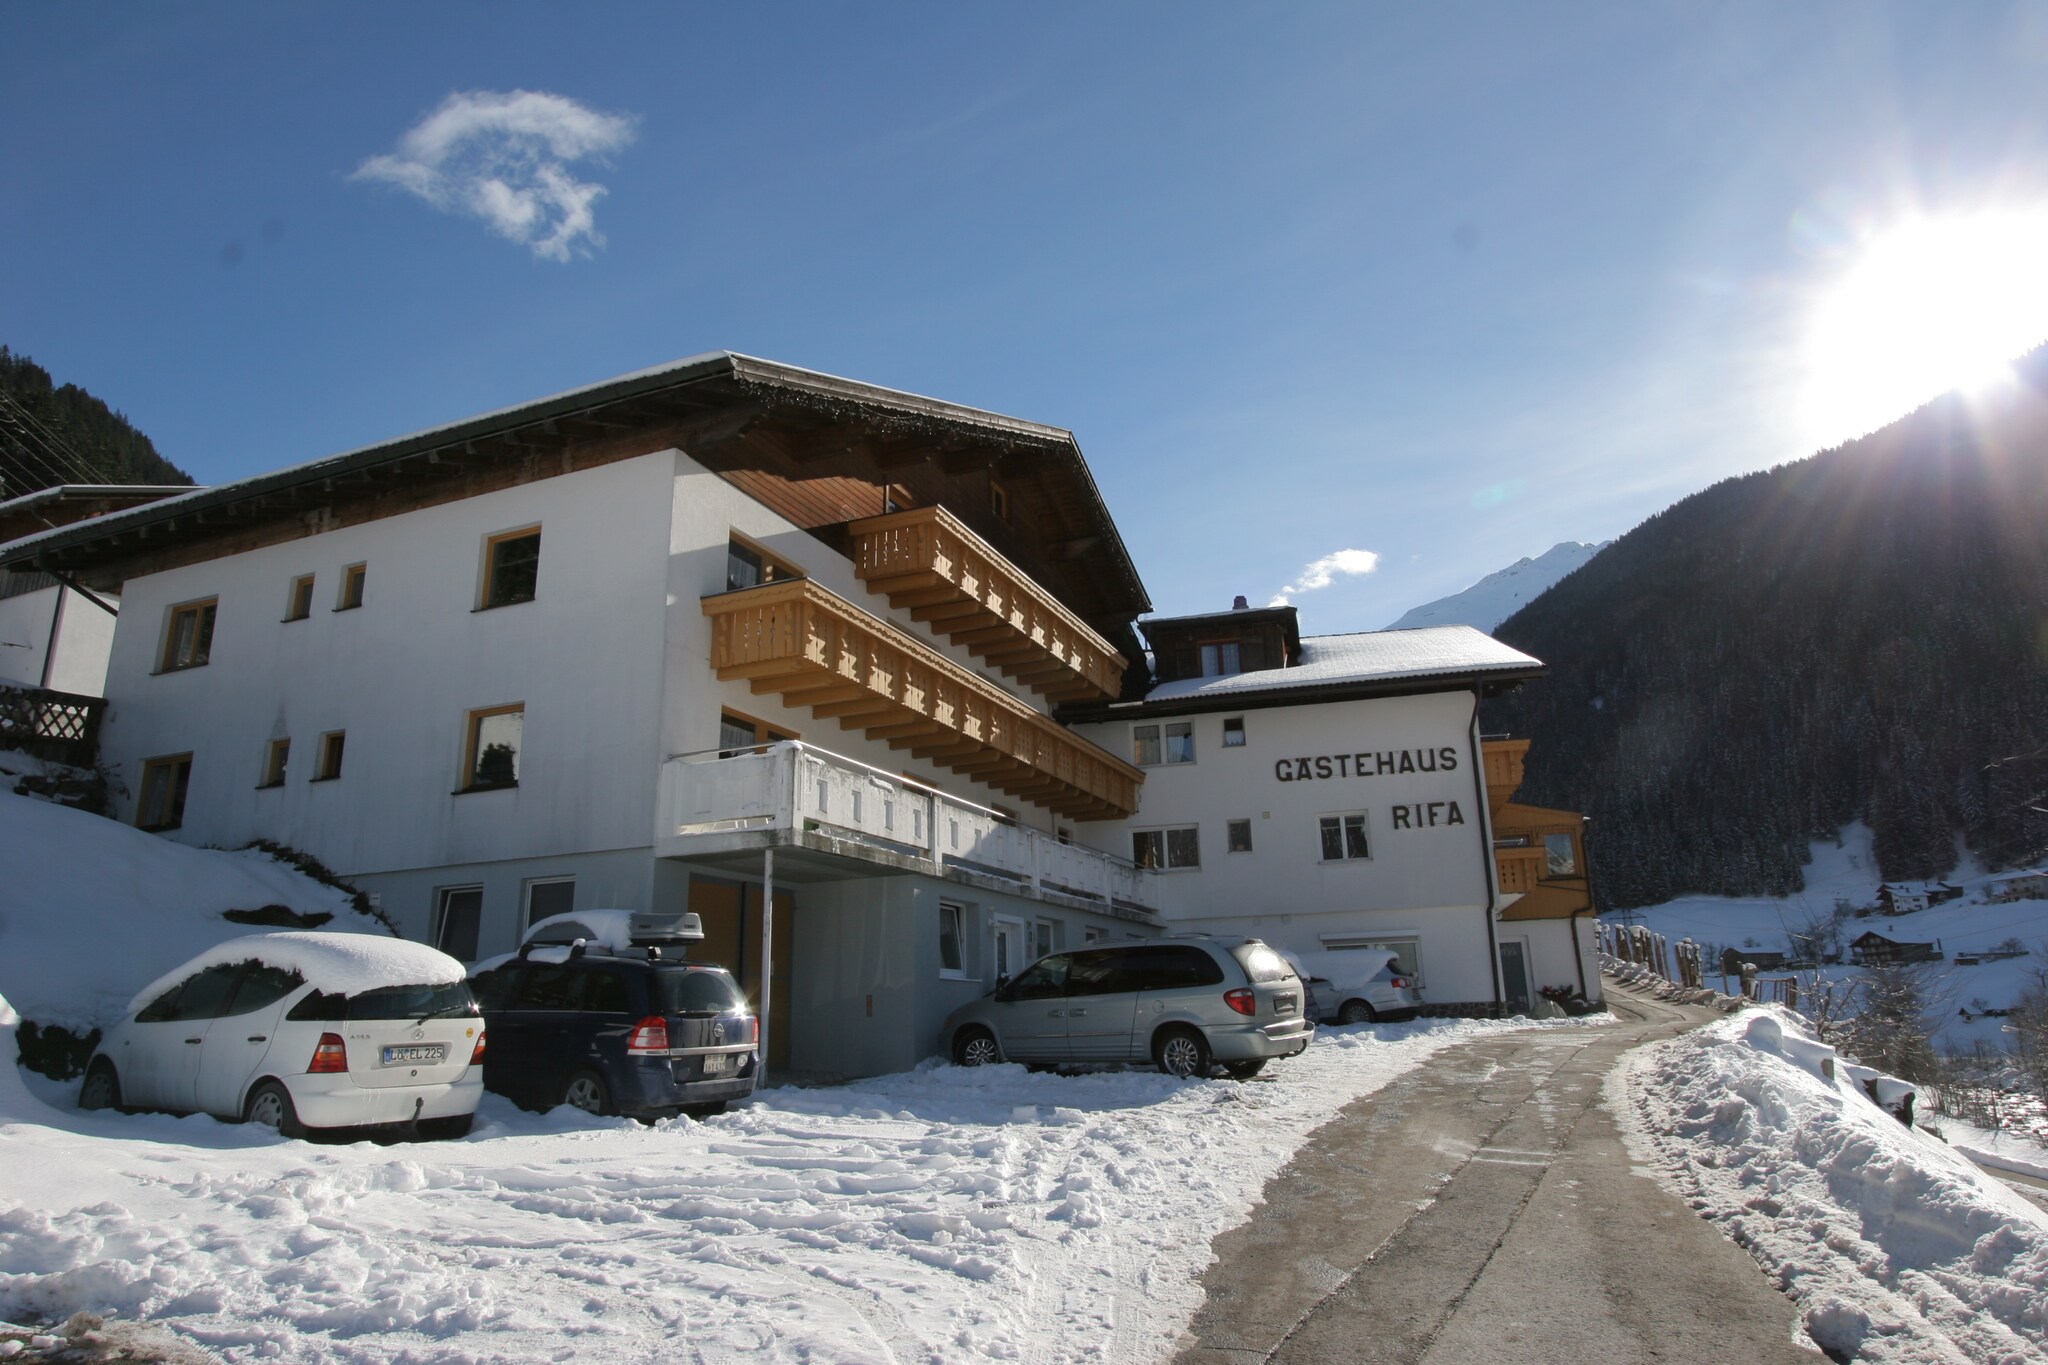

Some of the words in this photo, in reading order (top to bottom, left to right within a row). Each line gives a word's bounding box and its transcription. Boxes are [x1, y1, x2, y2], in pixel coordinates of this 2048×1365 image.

[1275, 747, 1457, 782] GÄSTEHAUS
[1392, 801, 1465, 830] RIFA
[410, 1048, 423, 1060] EL
[425, 1047, 443, 1060] 225
